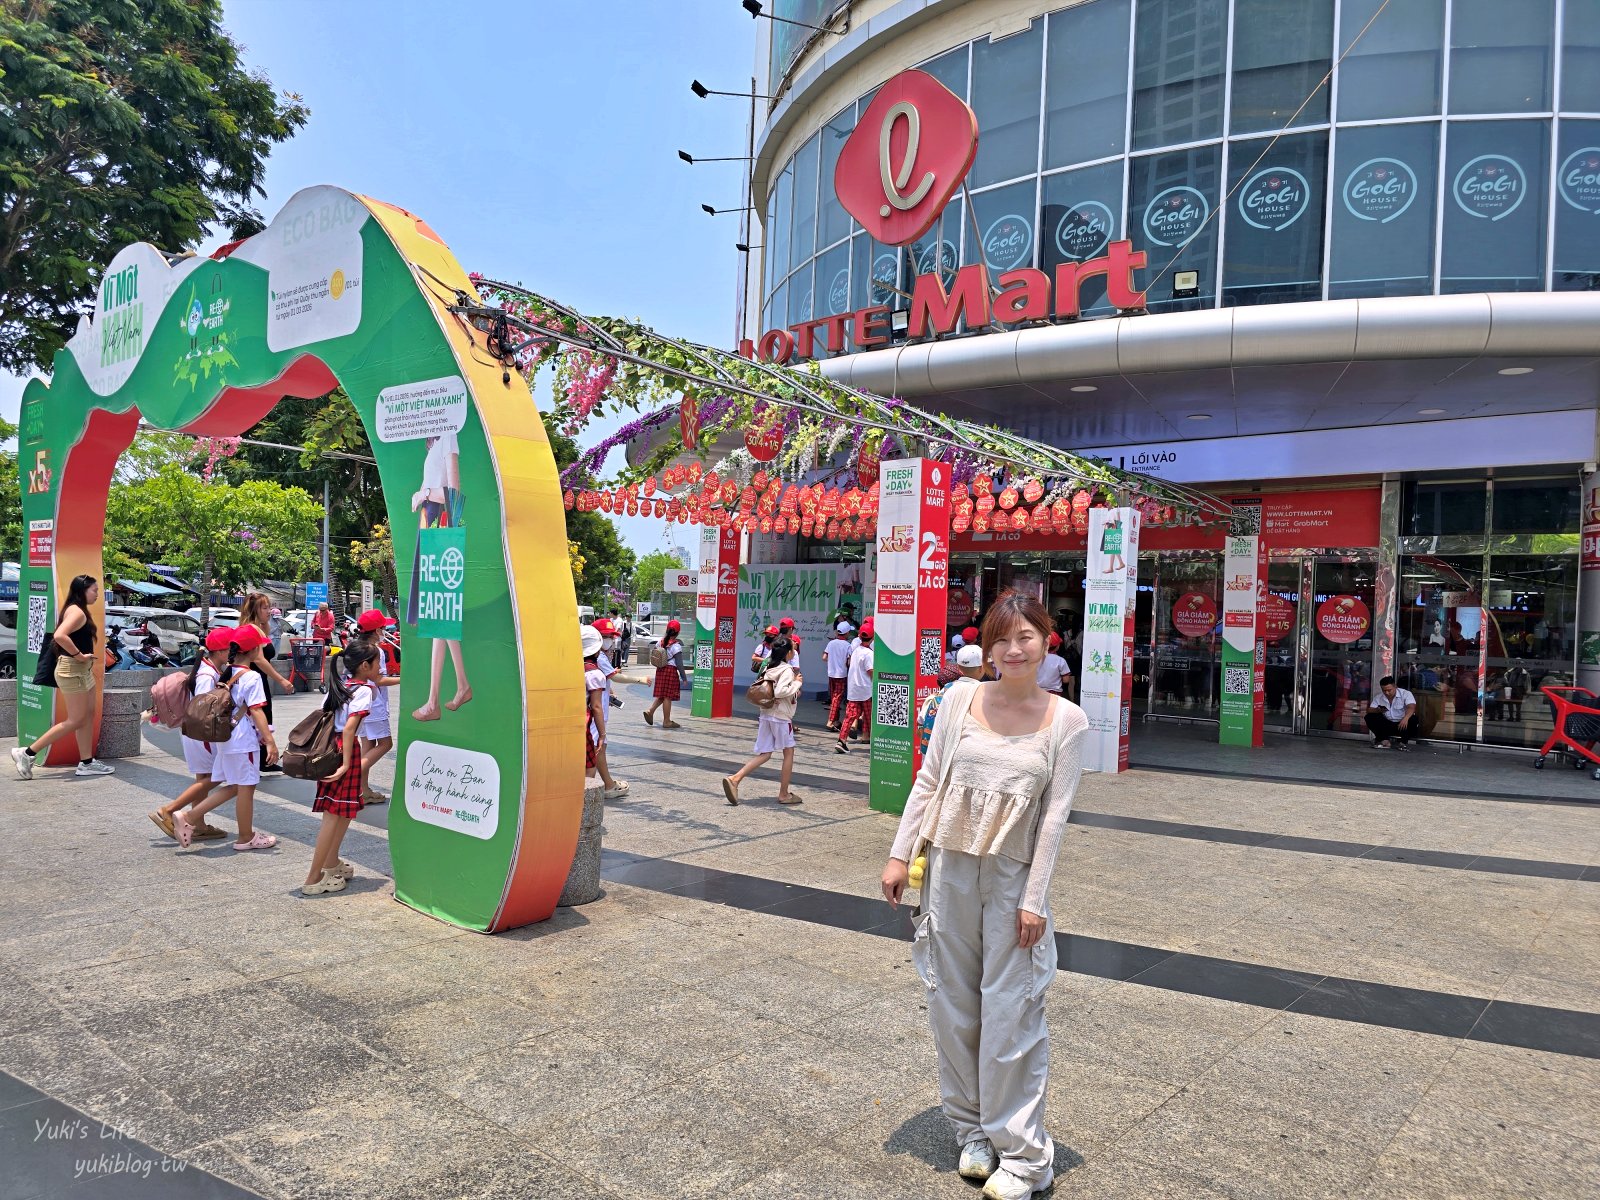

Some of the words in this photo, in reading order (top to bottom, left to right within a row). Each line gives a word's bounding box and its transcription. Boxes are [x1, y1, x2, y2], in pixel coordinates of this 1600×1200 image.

[1363, 196, 1398, 204] HOUSE
[1473, 193, 1509, 201] HOUSE
[1257, 205, 1291, 213] HOUSE
[282, 210, 316, 246] ECO
[1160, 221, 1191, 231] HOUSE
[1070, 235, 1098, 245] HOUSE
[994, 247, 1018, 257] HOUSE
[115, 264, 139, 306] Một
[738, 304, 891, 365] LOTTE
[908, 238, 1148, 338] Mart
[209, 314, 224, 330] EARTH
[394, 402, 408, 415] MỘT
[409, 398, 425, 413] VIỆT
[425, 398, 441, 408] NAM
[1131, 452, 1149, 465] LỐI
[1152, 450, 1177, 463] VÀO
[886, 468, 913, 481] FRESH
[890, 480, 908, 491] DAY
[926, 487, 945, 498] LOTTE
[926, 496, 945, 507] MART
[1266, 510, 1333, 518] WWW.LOTTEMART.VN
[1293, 519, 1329, 527] GrabMart
[919, 531, 937, 570] 2
[1104, 543, 1121, 551] EARTH
[1231, 541, 1252, 549] FRESH
[919, 570, 931, 588] LÀ
[933, 571, 946, 589] CÓ
[763, 569, 837, 612] XANH
[766, 578, 800, 604] Việt
[796, 577, 834, 602] Nam
[417, 590, 464, 622] EARTH
[739, 590, 762, 610] Một
[1099, 602, 1118, 616] Một
[1322, 614, 1337, 622] GIÁ
[1338, 614, 1360, 623] GIẢM
[1277, 621, 1290, 630] 1/5
[1322, 621, 1341, 629] ĐỒNG
[1342, 622, 1361, 630] HÀNH
[917, 685, 931, 698] MIỄN
[460, 764, 486, 785] Bạn
[445, 781, 469, 800] hành
[470, 794, 494, 818] cùng
[440, 807, 453, 816] MART
